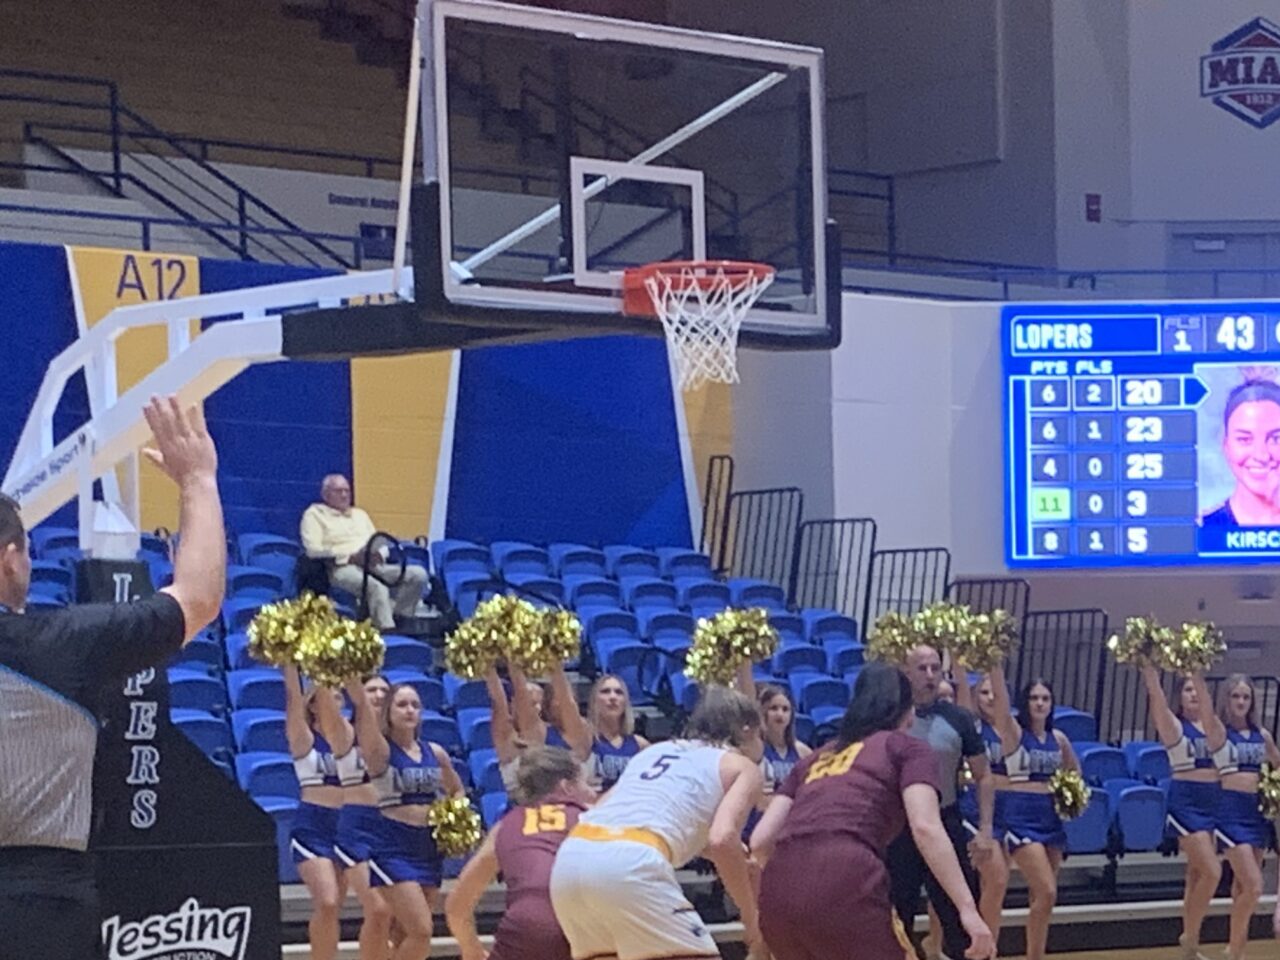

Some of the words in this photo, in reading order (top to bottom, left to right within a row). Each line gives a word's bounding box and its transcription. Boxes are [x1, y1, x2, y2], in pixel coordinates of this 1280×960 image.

[116, 254, 186, 301] A12
[1016, 324, 1093, 349] LOPERS
[1173, 331, 1192, 351] 1
[1216, 316, 1255, 350] 43
[1031, 360, 1068, 374] PTS
[1075, 360, 1113, 374] FLS
[1042, 383, 1056, 402] 6
[1087, 383, 1101, 402] 2
[1125, 380, 1162, 405] 20
[1042, 421, 1057, 439] 6
[1088, 421, 1101, 439] 1
[1126, 417, 1163, 442] 23
[1043, 458, 1057, 477] 4
[1089, 457, 1102, 476] 0
[1127, 454, 1163, 479] 25
[1039, 497, 1062, 512] 11
[1089, 495, 1103, 513] 0
[1127, 491, 1148, 516] 3
[1089, 532, 1103, 550] 1
[1128, 528, 1148, 553] 5
[113, 573, 160, 828] LPERS
[640, 755, 680, 780] 5
[522, 804, 566, 836] 15
[103, 901, 247, 960] lessing
